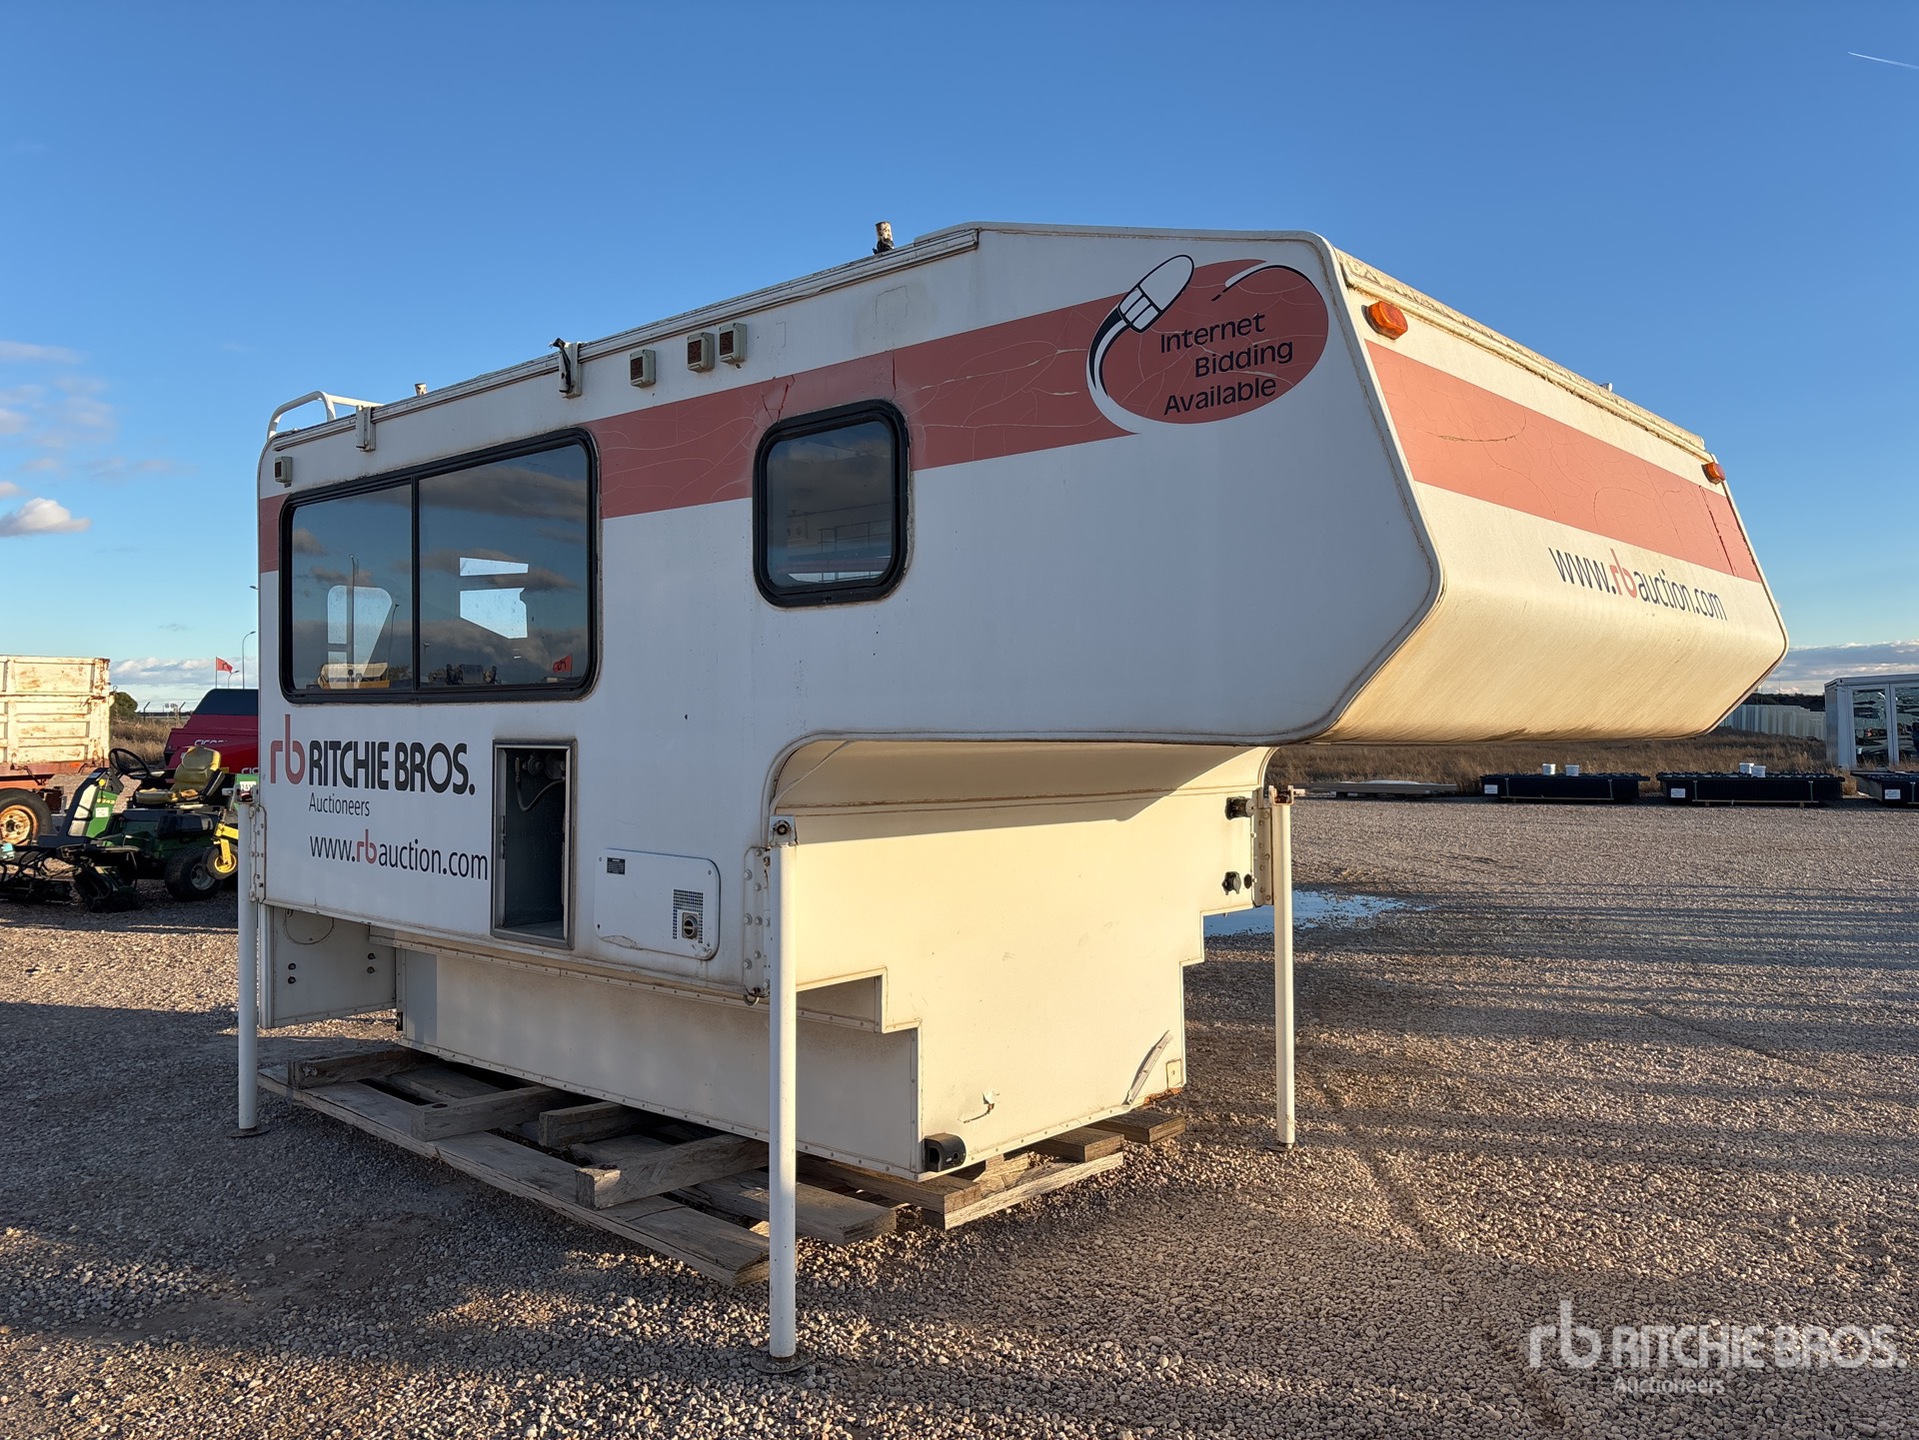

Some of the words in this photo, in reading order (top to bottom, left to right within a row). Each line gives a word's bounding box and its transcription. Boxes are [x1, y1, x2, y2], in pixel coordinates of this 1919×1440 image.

[1160, 312, 1266, 354] Internet
[1195, 341, 1294, 378] Bidding
[1163, 378, 1277, 416] Available
[1548, 547, 1728, 621] www.rbauction.com
[308, 740, 390, 790] RITCHIE
[394, 741, 476, 796] BROS.
[308, 792, 371, 817] Auctioneers
[309, 828, 489, 881] www.rbauction.com
